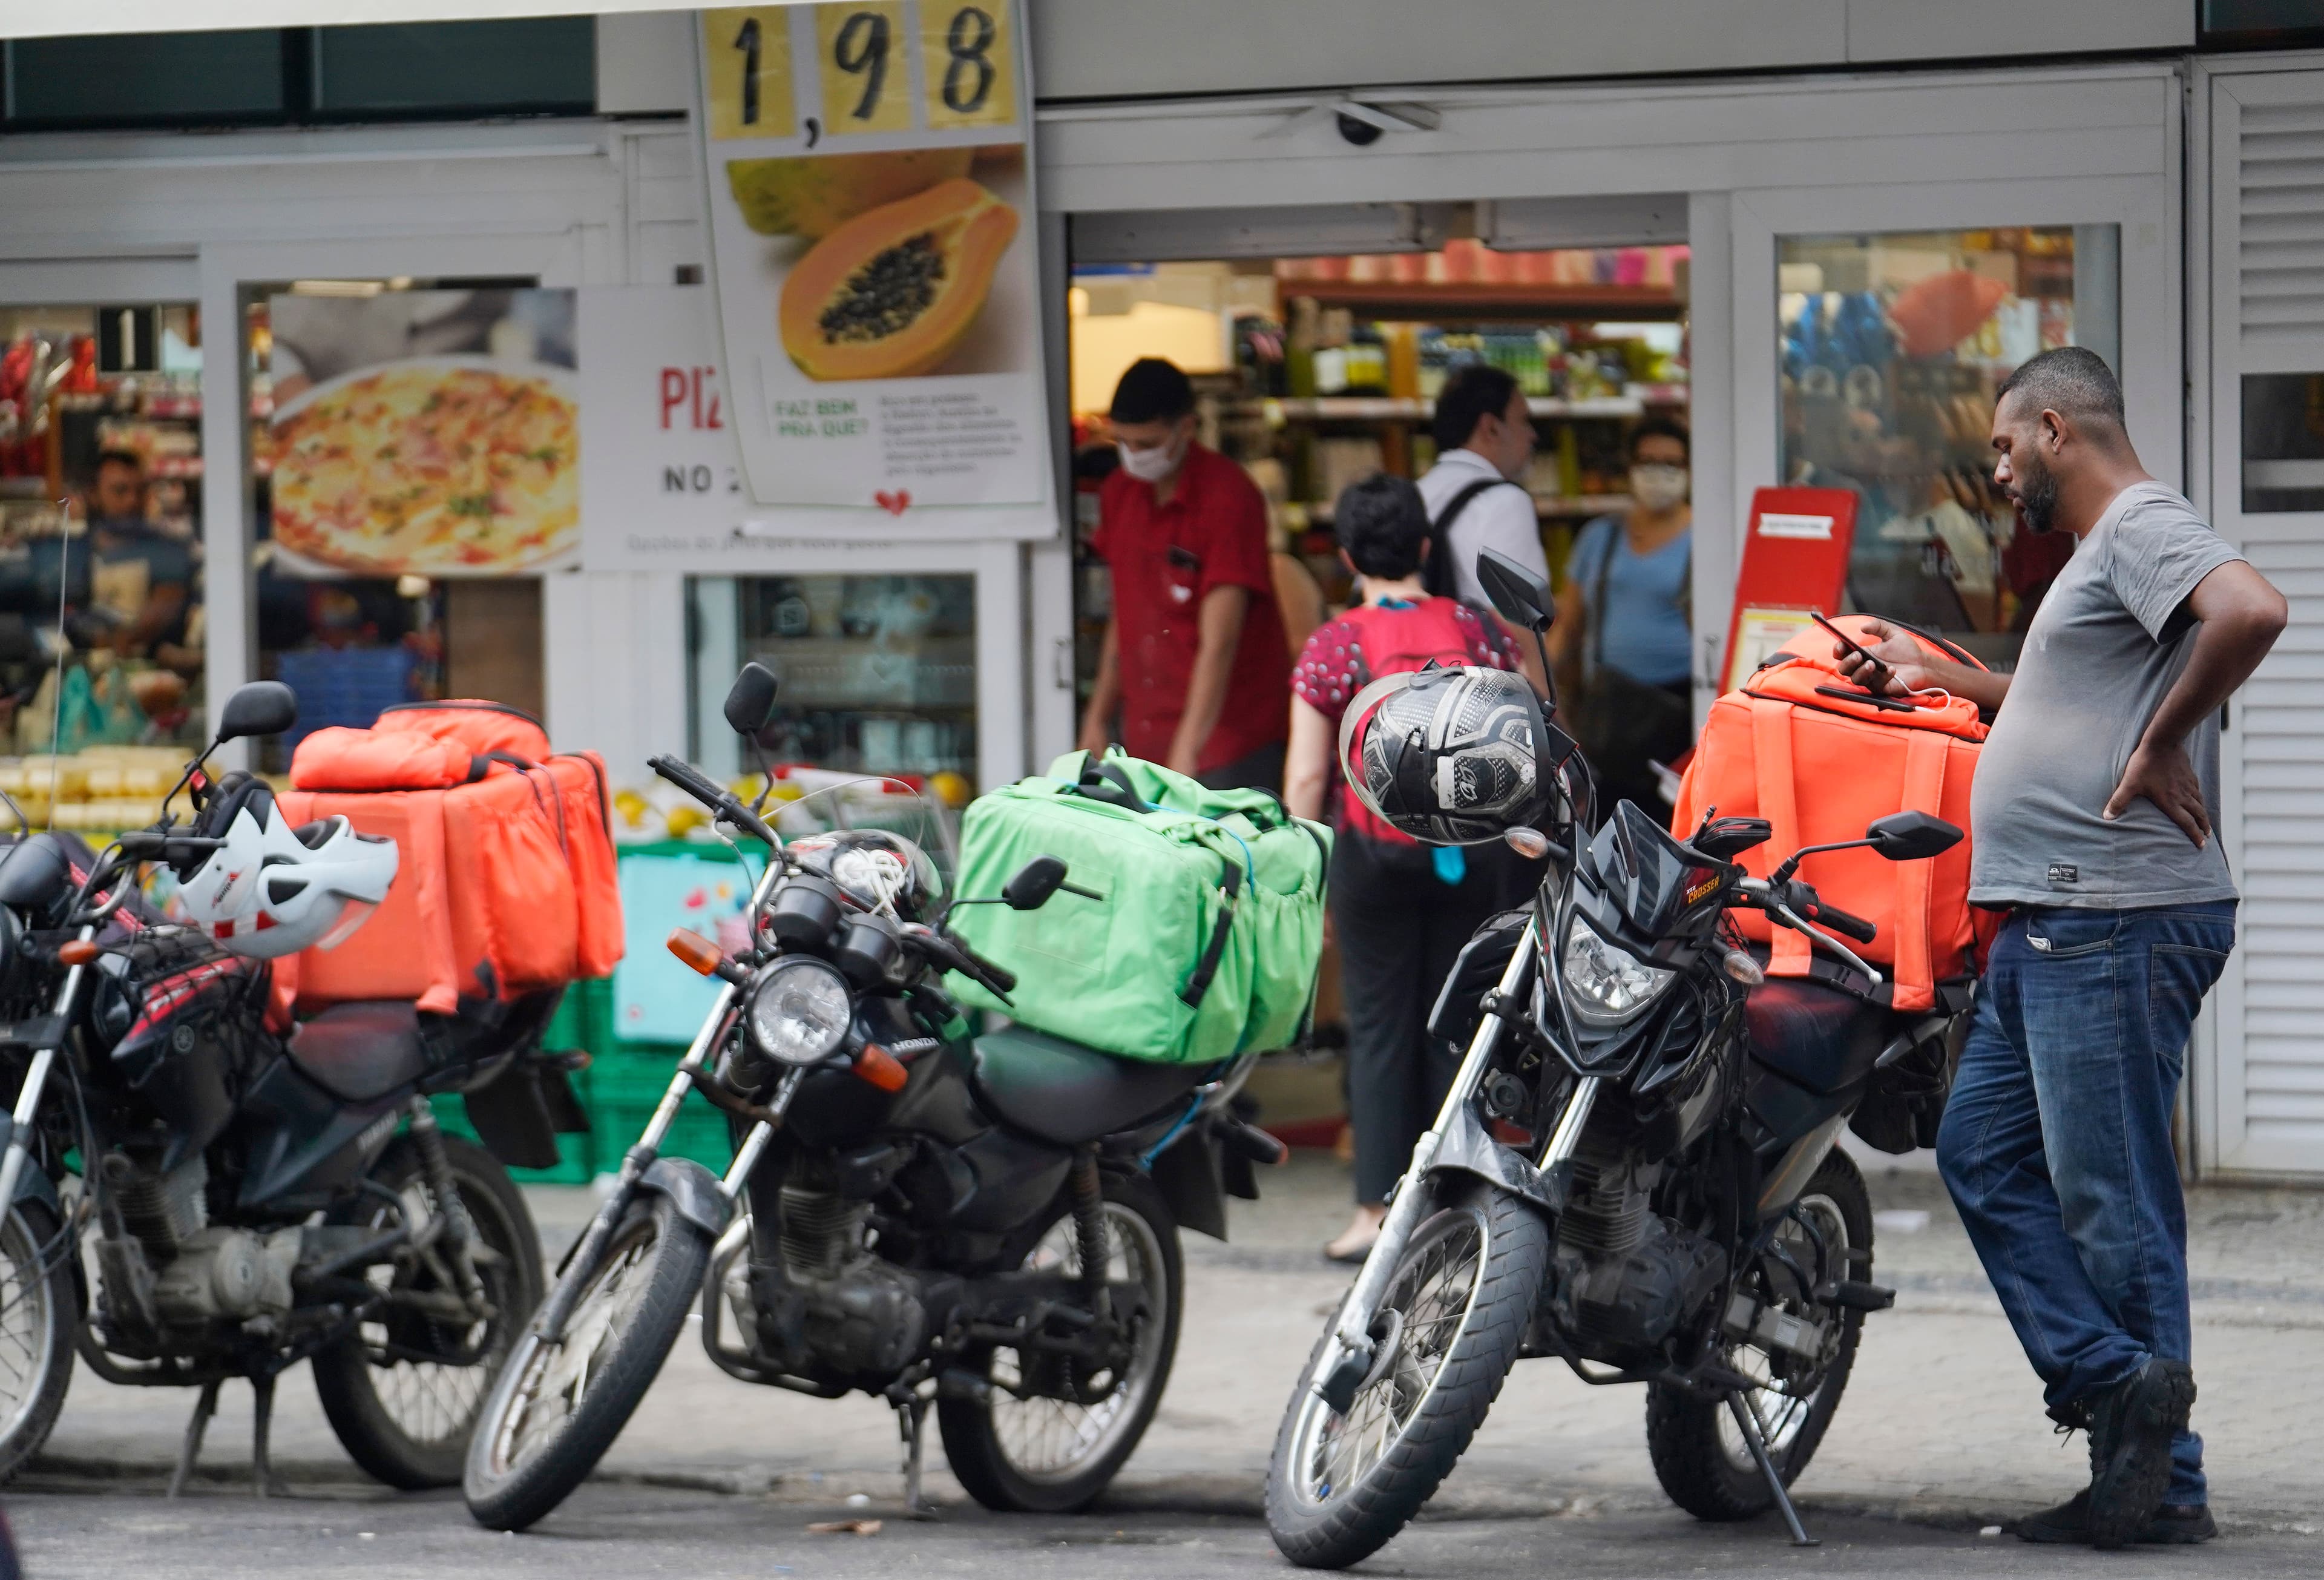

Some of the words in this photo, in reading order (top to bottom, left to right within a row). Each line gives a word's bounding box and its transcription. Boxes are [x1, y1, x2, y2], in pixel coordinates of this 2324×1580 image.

[663, 464, 712, 493] NO
[1686, 885, 1696, 895] XTZ
[1688, 875, 1720, 904] CROSSER
[891, 1037, 940, 1052] HONDA
